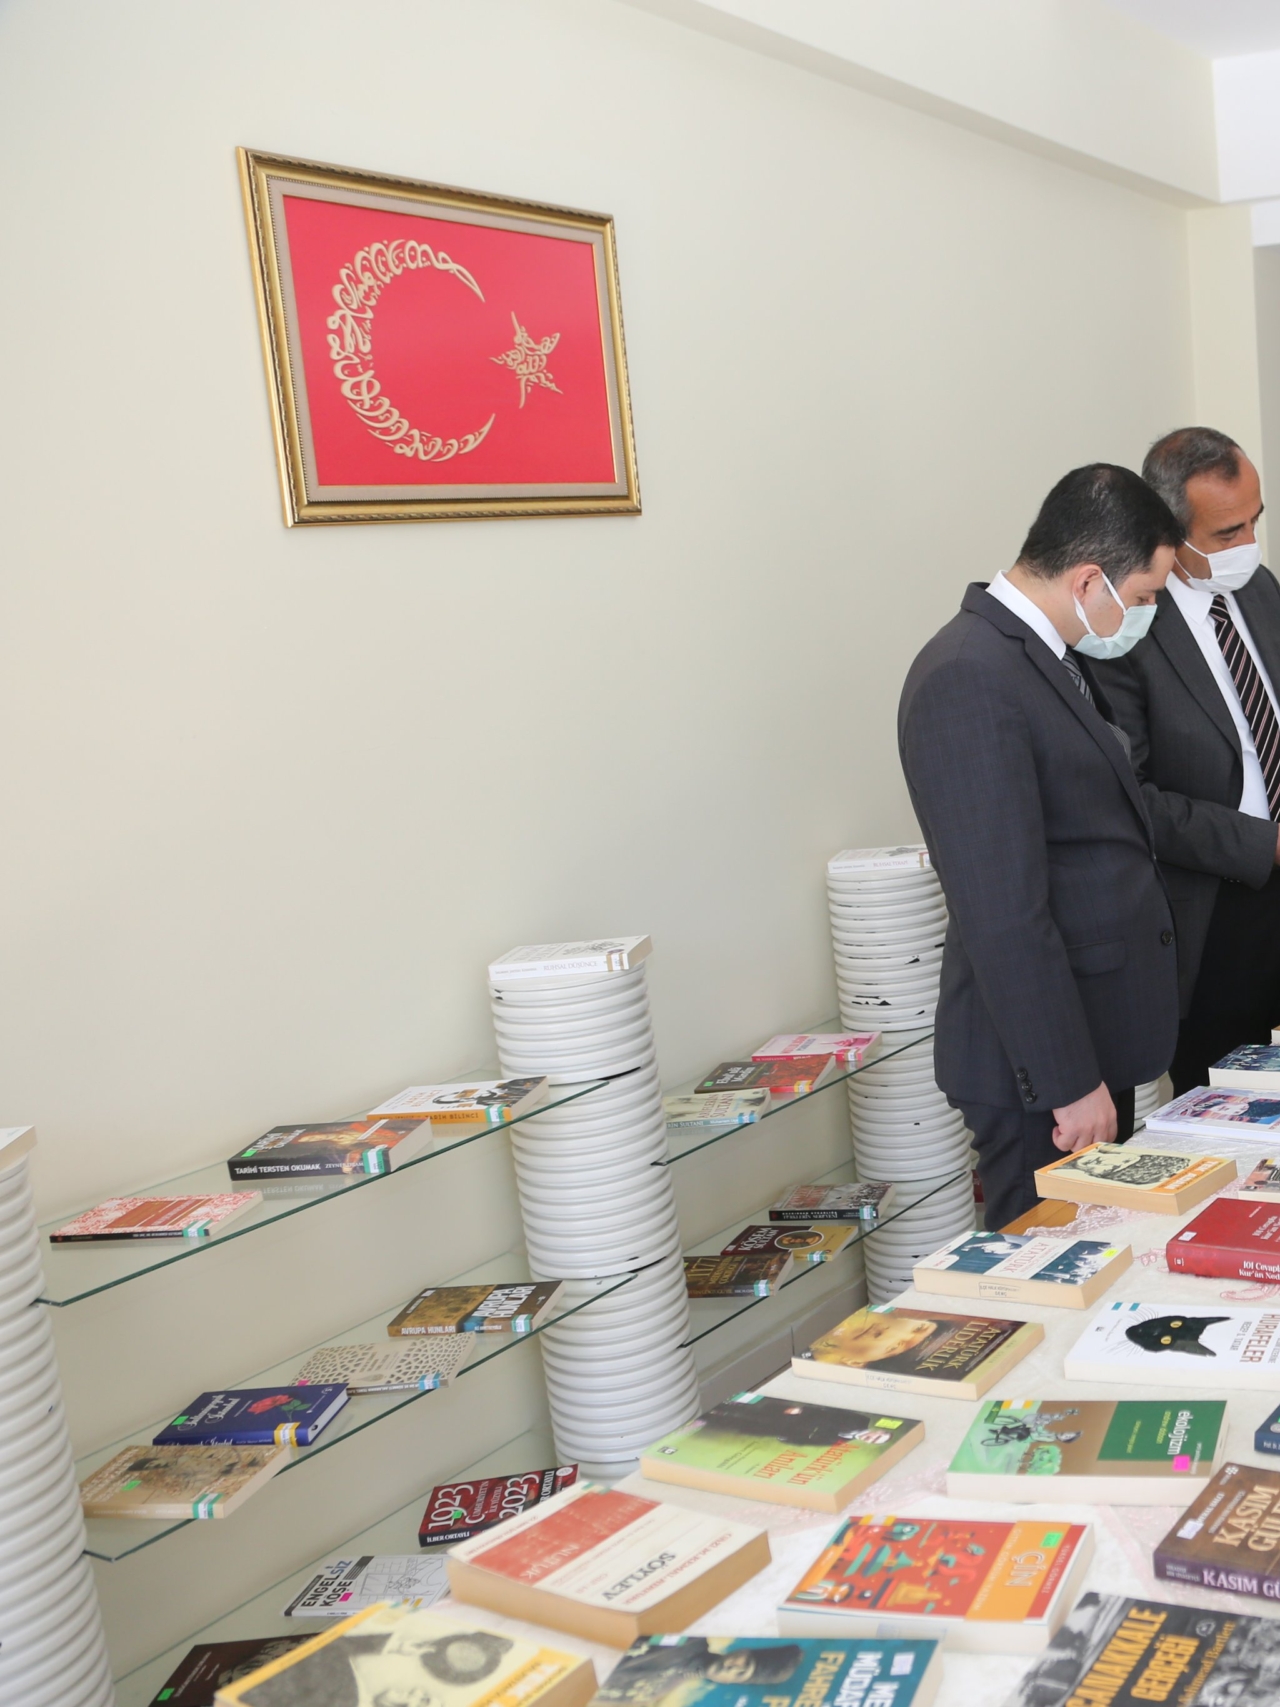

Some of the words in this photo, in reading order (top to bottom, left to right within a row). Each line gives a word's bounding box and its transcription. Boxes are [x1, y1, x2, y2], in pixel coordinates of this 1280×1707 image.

[234, 1166, 258, 1175] TARİHİ
[258, 1165, 290, 1174] TERSTEN
[291, 1163, 321, 1172] OKUMAK
[738, 1227, 773, 1251] KÖSEM
[1243, 1260, 1254, 1270] 101
[471, 1287, 515, 1317] AVRUPA
[490, 1285, 537, 1318] HUNLARI
[401, 1327, 426, 1335] AVRUPA
[427, 1325, 456, 1333] HUNLARI
[915, 1320, 989, 1371] LİDERLİK
[943, 1326, 1002, 1370] ATATÜRK
[1167, 1409, 1194, 1455] ekolojizm
[754, 1449, 808, 1480] Anıları
[787, 1439, 860, 1485] Atatürk'ün
[428, 1484, 474, 1530] 1923
[499, 1474, 540, 1519] 2023
[1212, 1484, 1280, 1547] KASIM
[427, 1535, 444, 1543] İLBER
[445, 1531, 470, 1542] ORTAYLI
[601, 1550, 676, 1601] SÖYLEV
[1005, 1550, 1047, 1588] ÇİN
[1202, 1569, 1259, 1594] KASIM
[319, 1581, 353, 1607] KÖŞE
[794, 1650, 846, 1707] FAHRE
[833, 1650, 883, 1707] MÜDA
[1130, 1633, 1200, 1702] GERÇEĞİ
